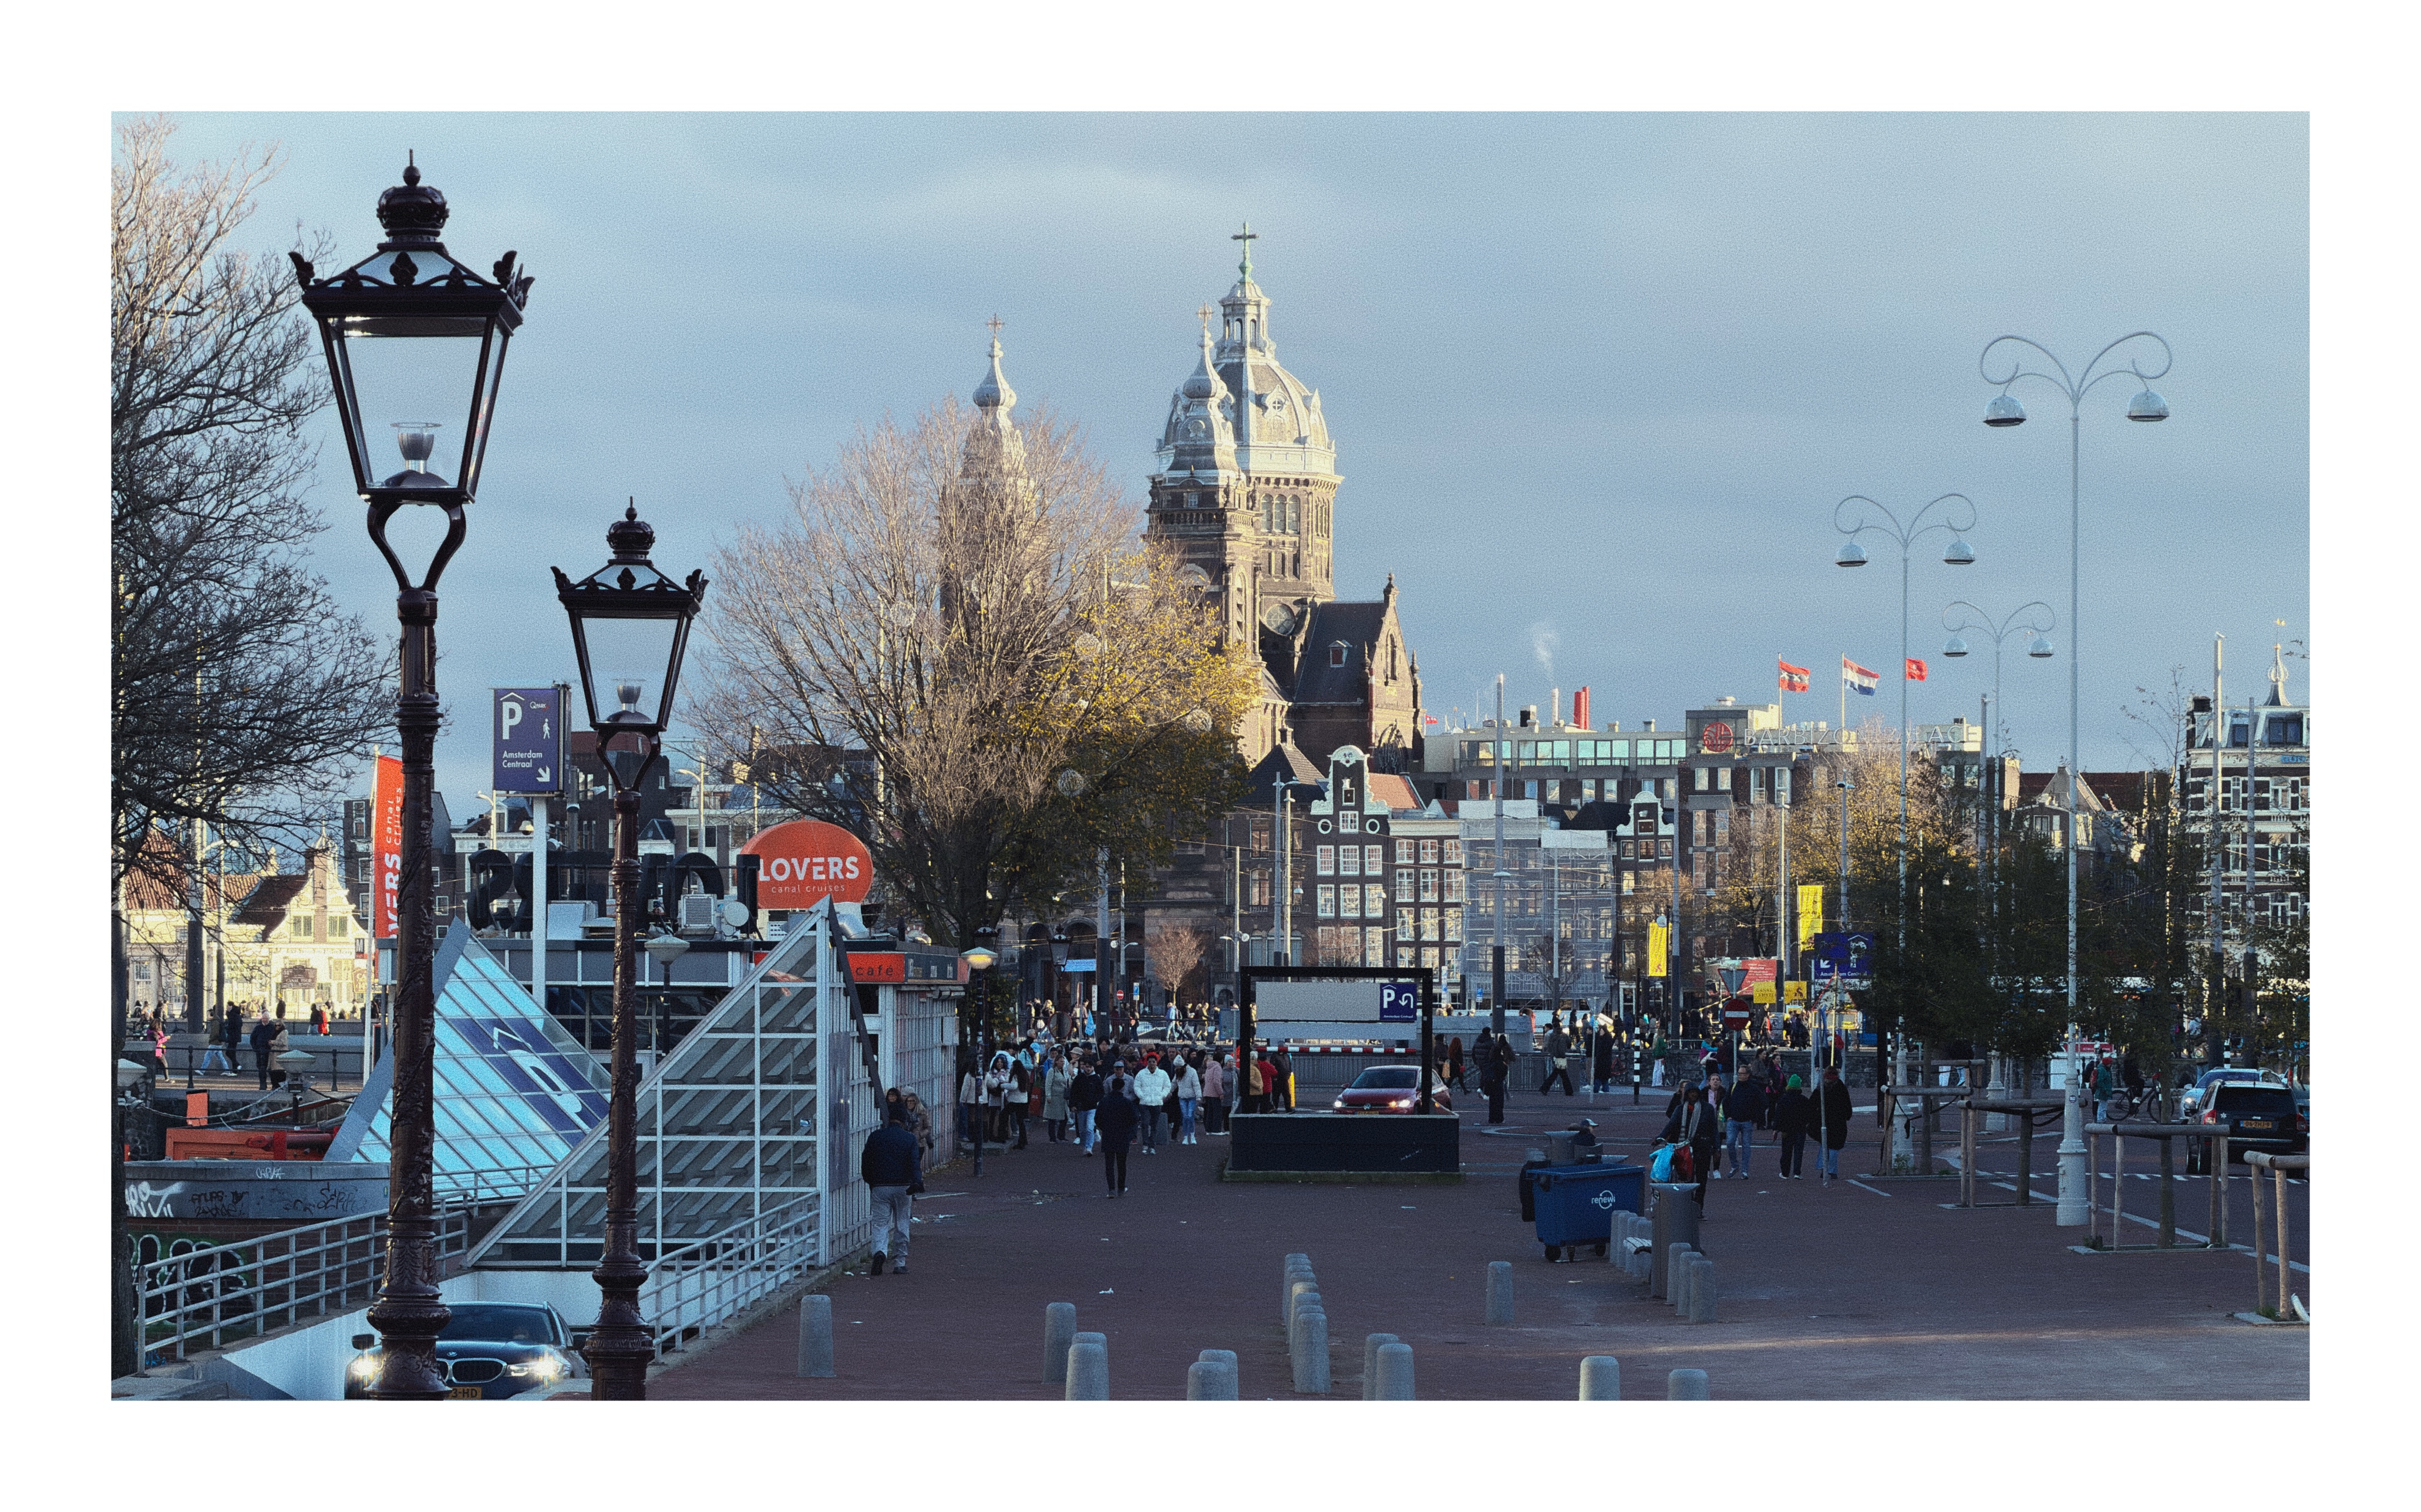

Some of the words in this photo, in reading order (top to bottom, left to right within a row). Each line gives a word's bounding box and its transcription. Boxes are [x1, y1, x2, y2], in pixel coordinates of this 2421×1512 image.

[503, 702, 522, 739] P
[503, 750, 543, 759] Amsterdam
[503, 759, 532, 768] Centraal
[759, 856, 859, 881] LOVERS
[772, 885, 800, 893] canal
[806, 884, 845, 893] cruises
[856, 965, 893, 976] café
[1383, 989, 1395, 1008] P
[452, 1388, 477, 1398] 3-HD
